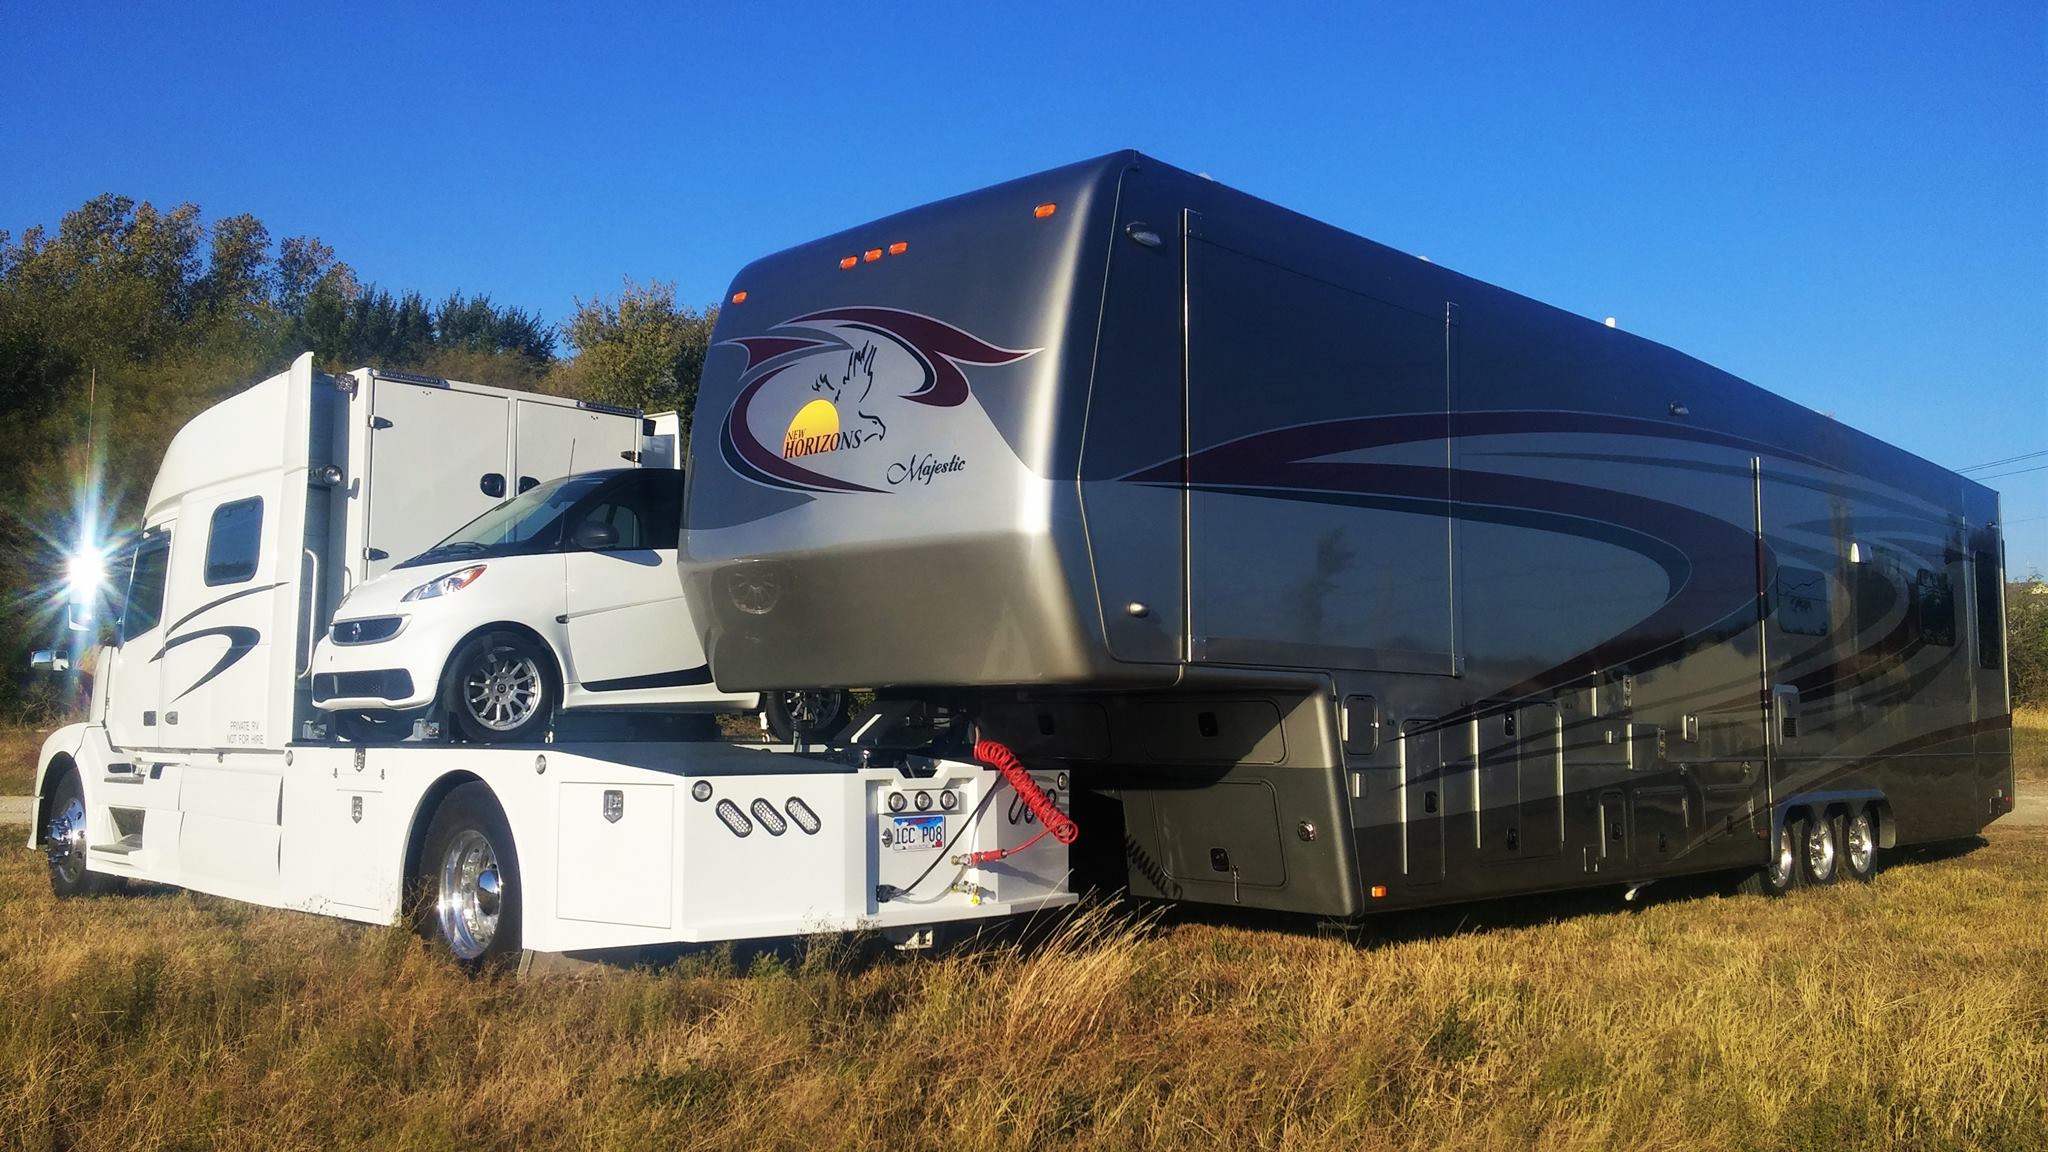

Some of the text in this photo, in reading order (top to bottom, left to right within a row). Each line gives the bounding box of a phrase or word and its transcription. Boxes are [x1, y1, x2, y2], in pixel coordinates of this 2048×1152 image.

[787, 428, 807, 440] NEW
[784, 429, 862, 459] HORIZONS
[886, 453, 966, 486] Majestic
[230, 720, 249, 731] PRIVATE
[226, 733, 264, 745] NOT FOR HIRE
